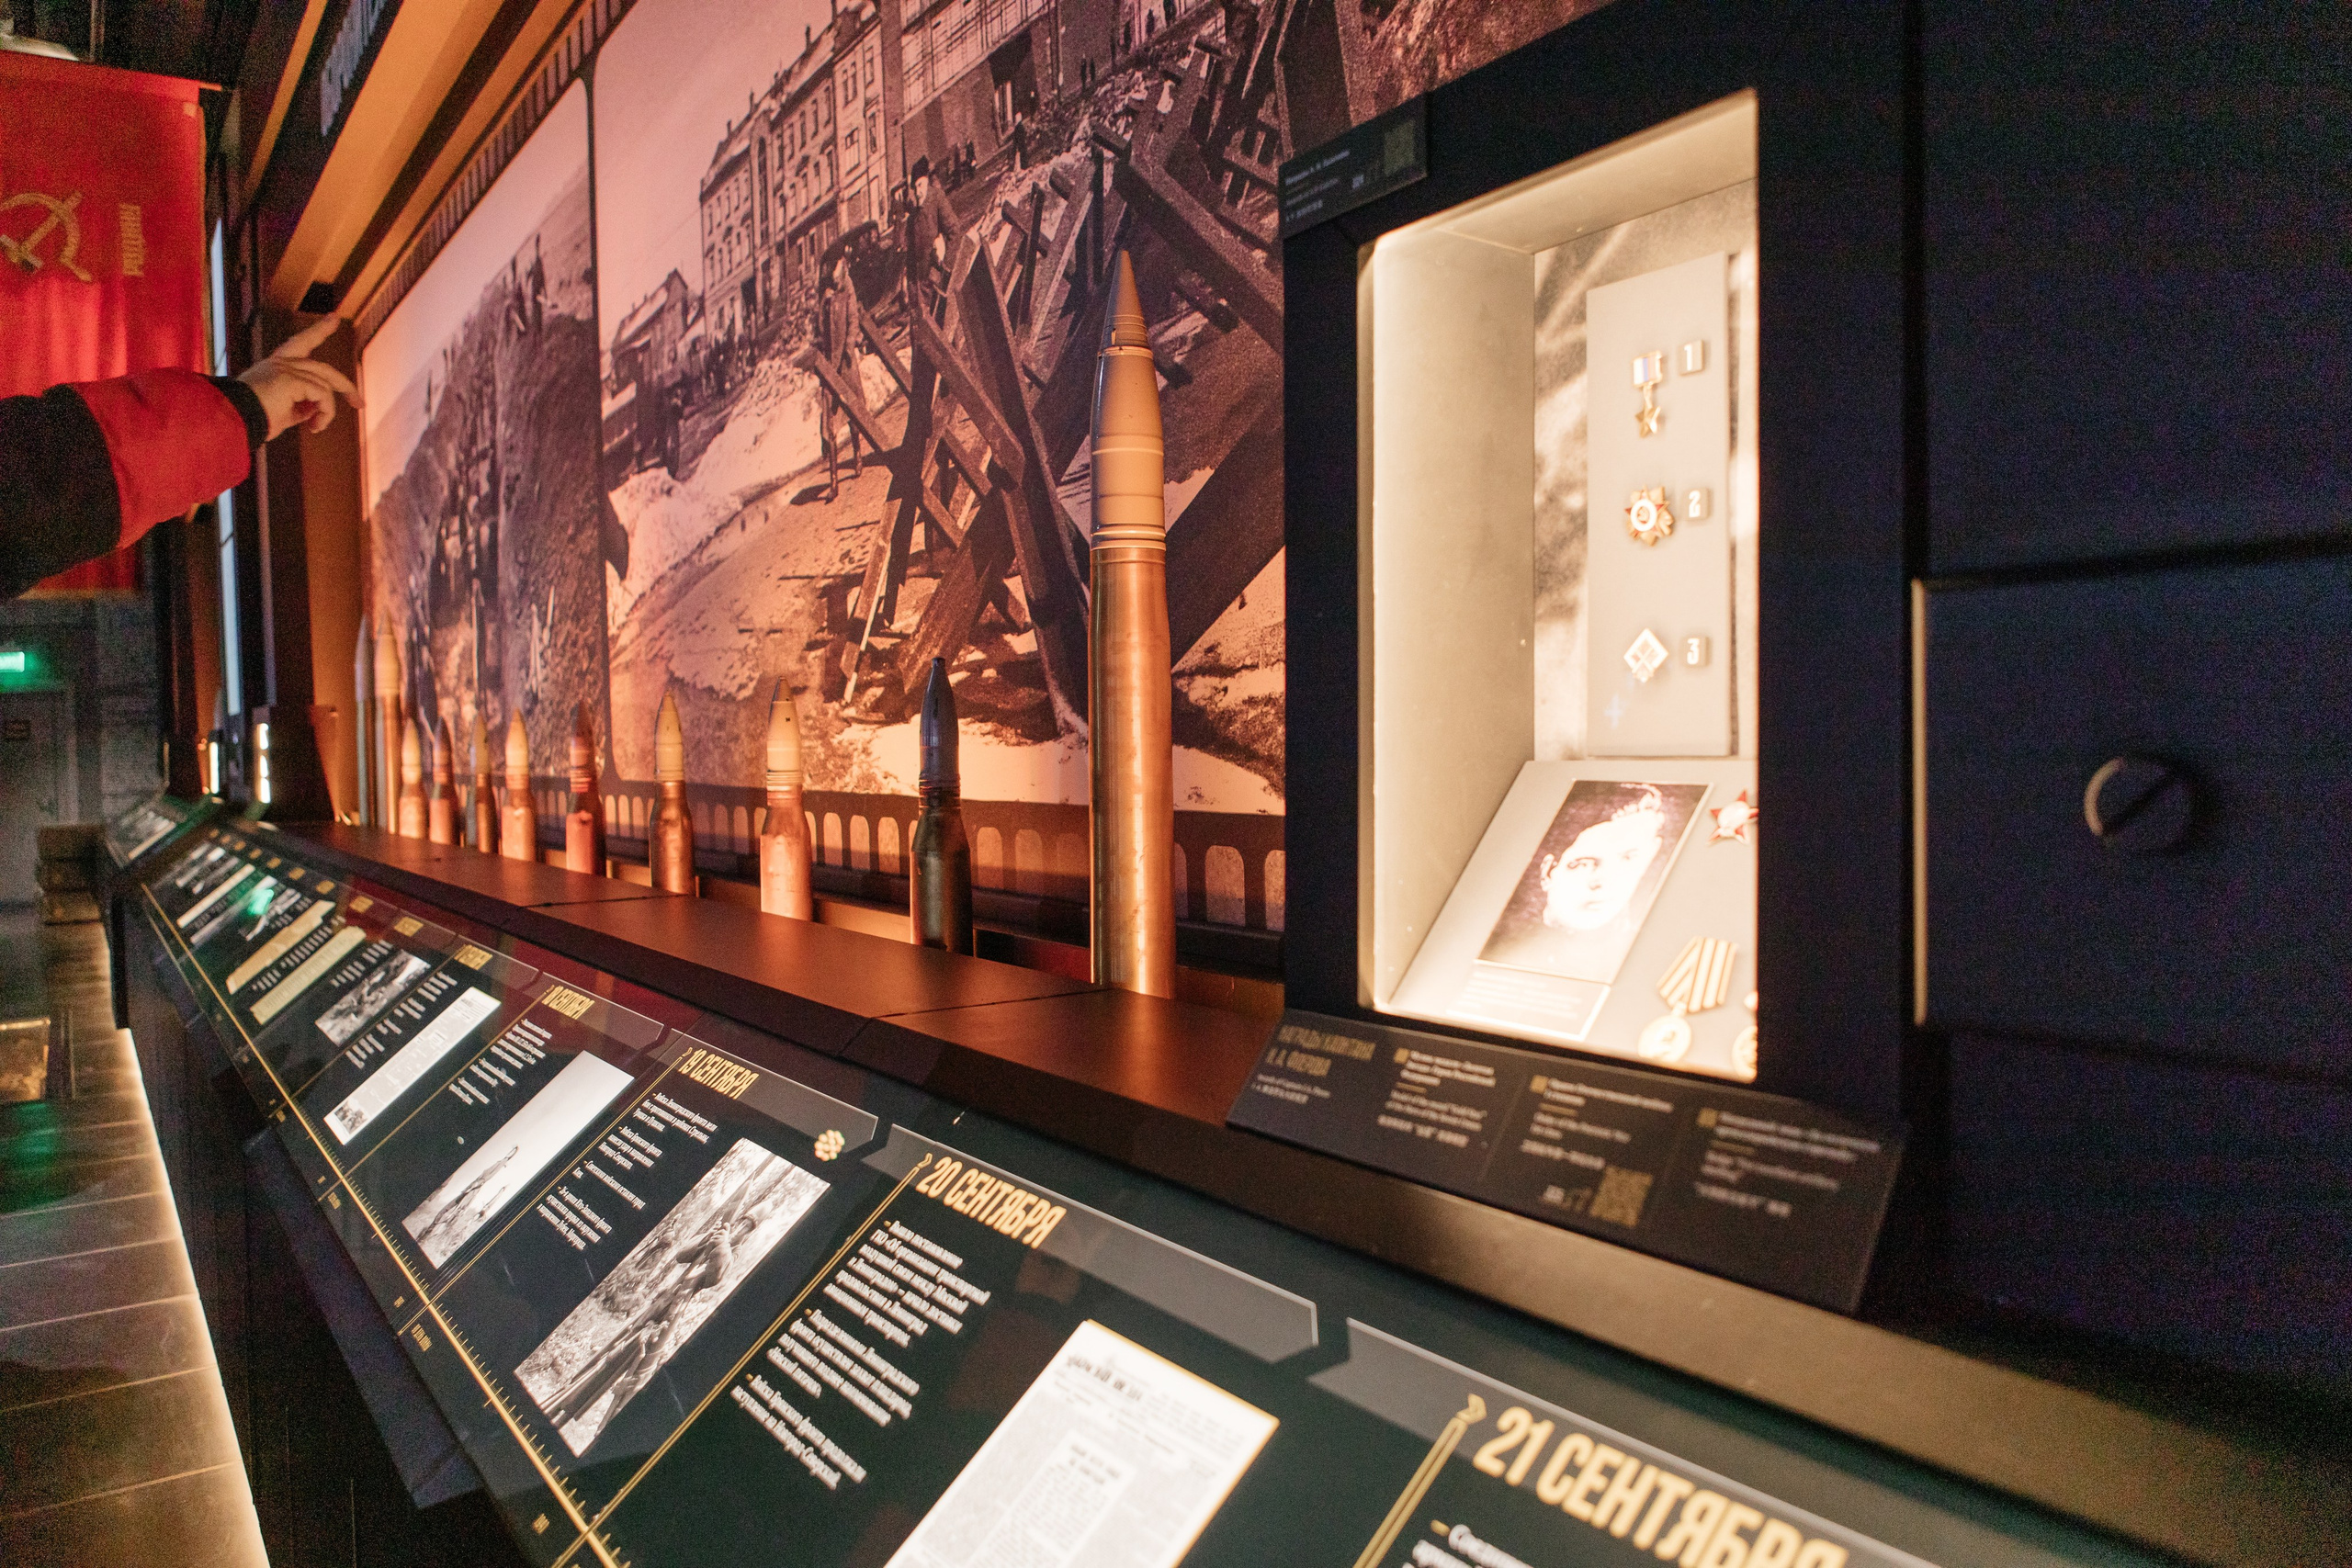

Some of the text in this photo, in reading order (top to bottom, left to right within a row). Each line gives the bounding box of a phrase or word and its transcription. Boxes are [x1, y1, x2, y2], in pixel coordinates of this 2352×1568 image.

[1684, 344, 1692, 371] 1
[1689, 490, 1701, 518] 2
[1687, 637, 1699, 665] 3
[678, 1049, 760, 1100] 19 СЕНТЯБРЯ
[915, 1156, 1068, 1250] 20 СЕНТЯБРЯ
[1473, 1405, 1555, 1486] 21
